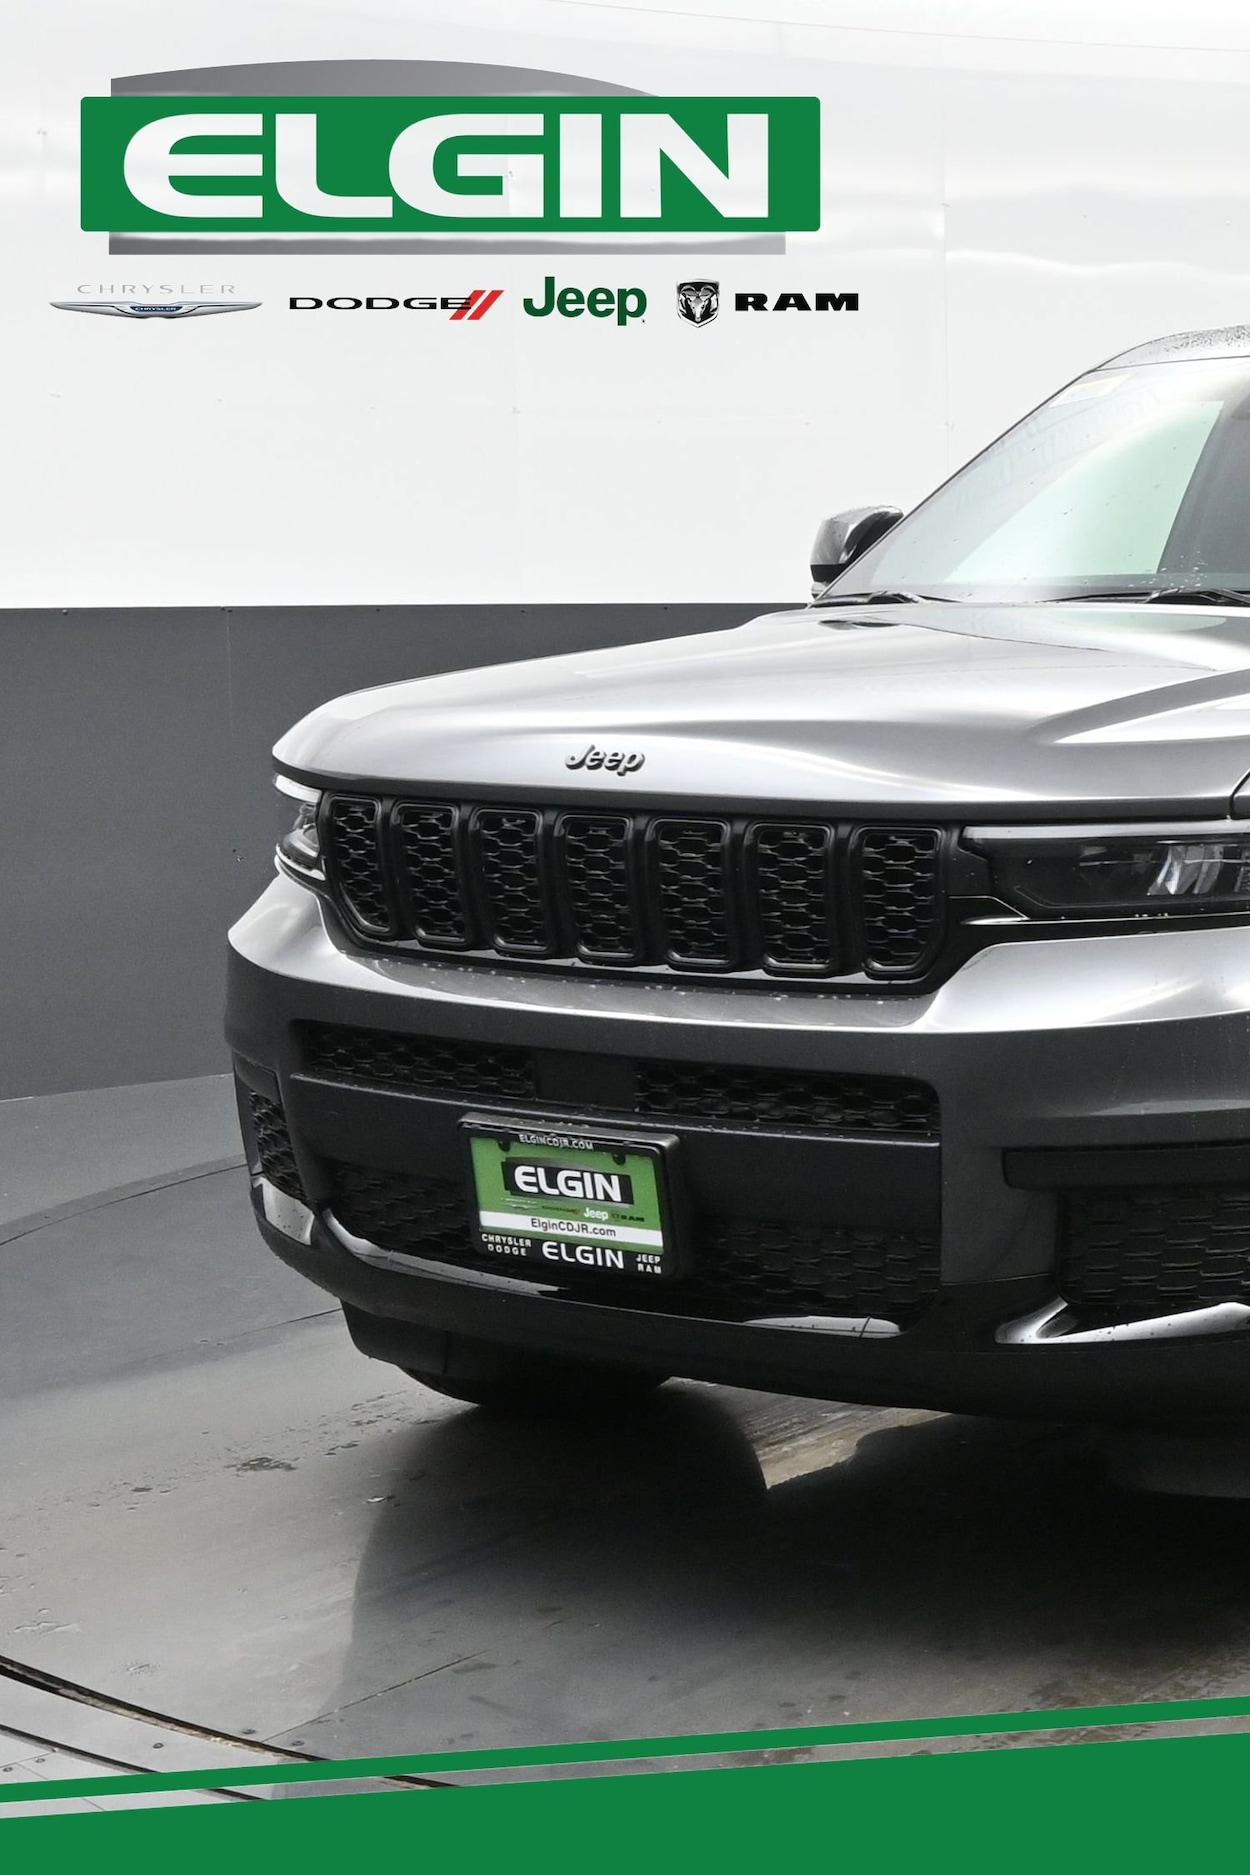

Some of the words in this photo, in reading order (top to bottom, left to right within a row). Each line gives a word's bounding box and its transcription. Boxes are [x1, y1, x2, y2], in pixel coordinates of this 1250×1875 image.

[565, 744, 646, 777] Jeep
[519, 1133, 595, 1150] ELGINCDJR.COM
[514, 1164, 622, 1203] ELGIN
[583, 1206, 609, 1222] Jeep
[530, 1217, 617, 1238] ElginCDJR.com
[481, 1233, 532, 1248] CHRYSLER
[487, 1243, 528, 1257] DODGE
[541, 1241, 625, 1270] ELGIN
[635, 1253, 661, 1264] JEEP
[637, 1263, 662, 1275] RAM
